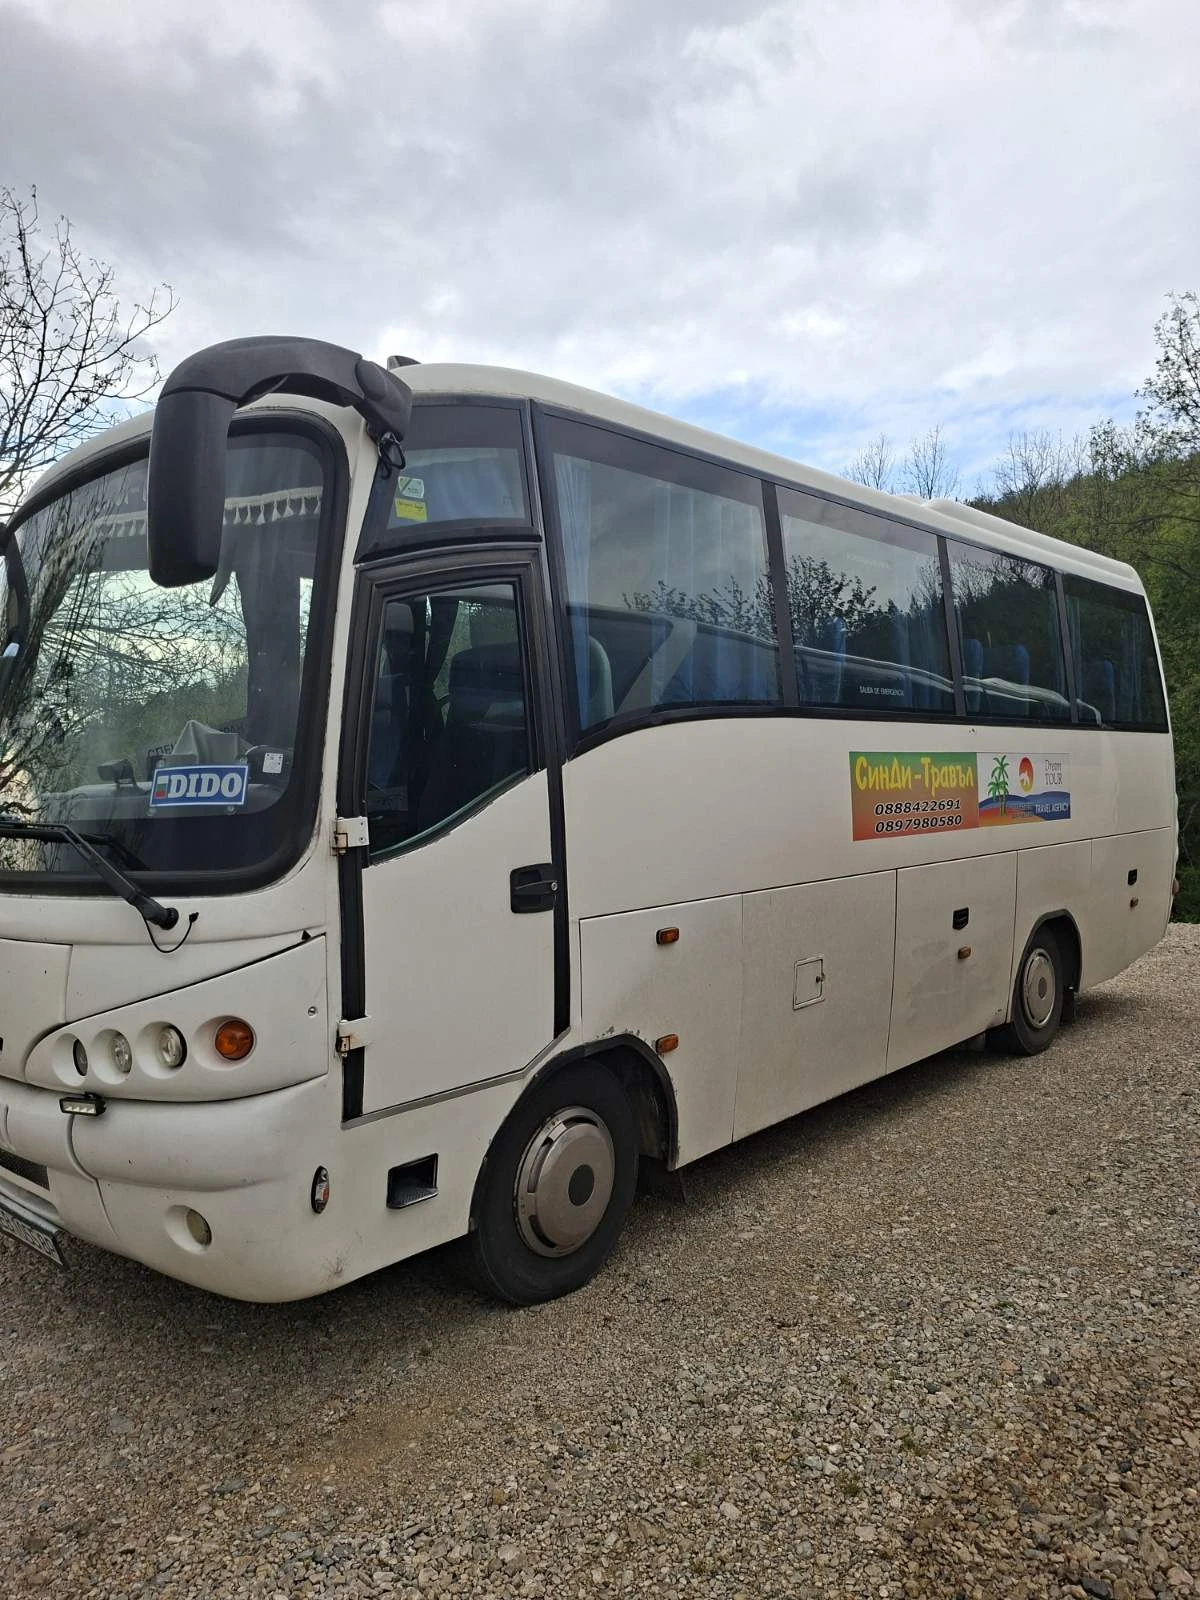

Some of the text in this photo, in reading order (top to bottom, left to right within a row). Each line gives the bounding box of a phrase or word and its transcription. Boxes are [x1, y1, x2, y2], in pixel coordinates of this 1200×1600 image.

[167, 772, 243, 799] DIDO
[1045, 773, 1063, 785] TOUR
[874, 798, 962, 817] 0888422691
[1035, 803, 1051, 814] TRAVEL
[1052, 802, 1069, 812] AGENCY
[875, 814, 963, 834] 0897980580
